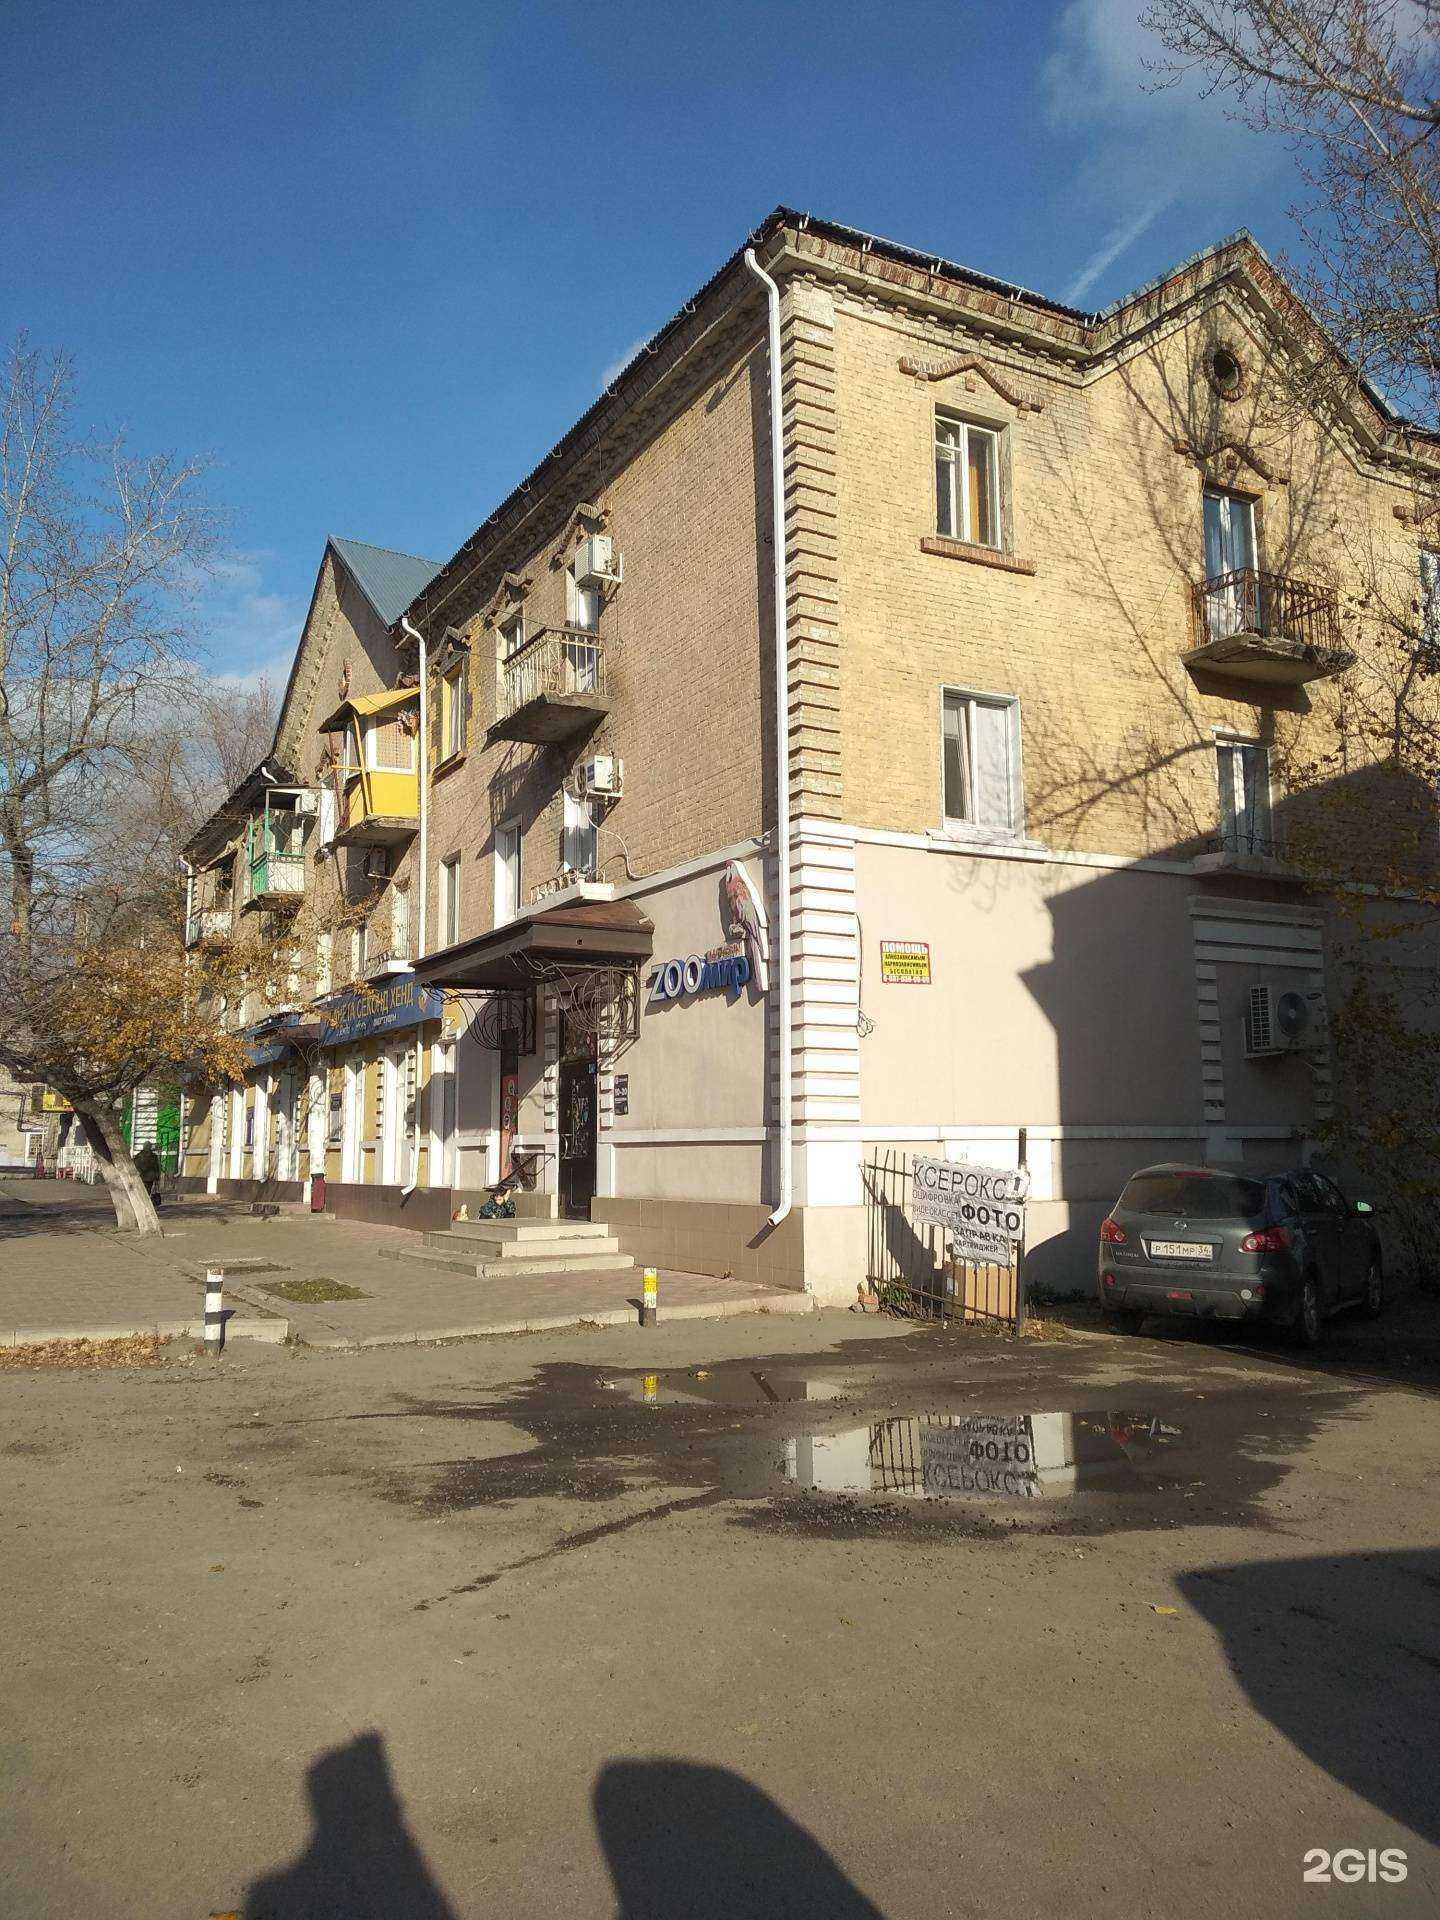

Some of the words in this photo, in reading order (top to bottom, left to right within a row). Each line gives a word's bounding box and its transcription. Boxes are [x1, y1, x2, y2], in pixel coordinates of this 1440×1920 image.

[882, 942, 928, 954] ПОМОЩЬ
[390, 981, 414, 1009] ХЕНД
[913, 1164, 1007, 1201] КСЕРОКС
[961, 1203, 1021, 1232] ФОТО
[953, 1226, 1008, 1243] ЗАПРАВКА
[954, 1239, 999, 1253] КАРТРИДЖЕЙ
